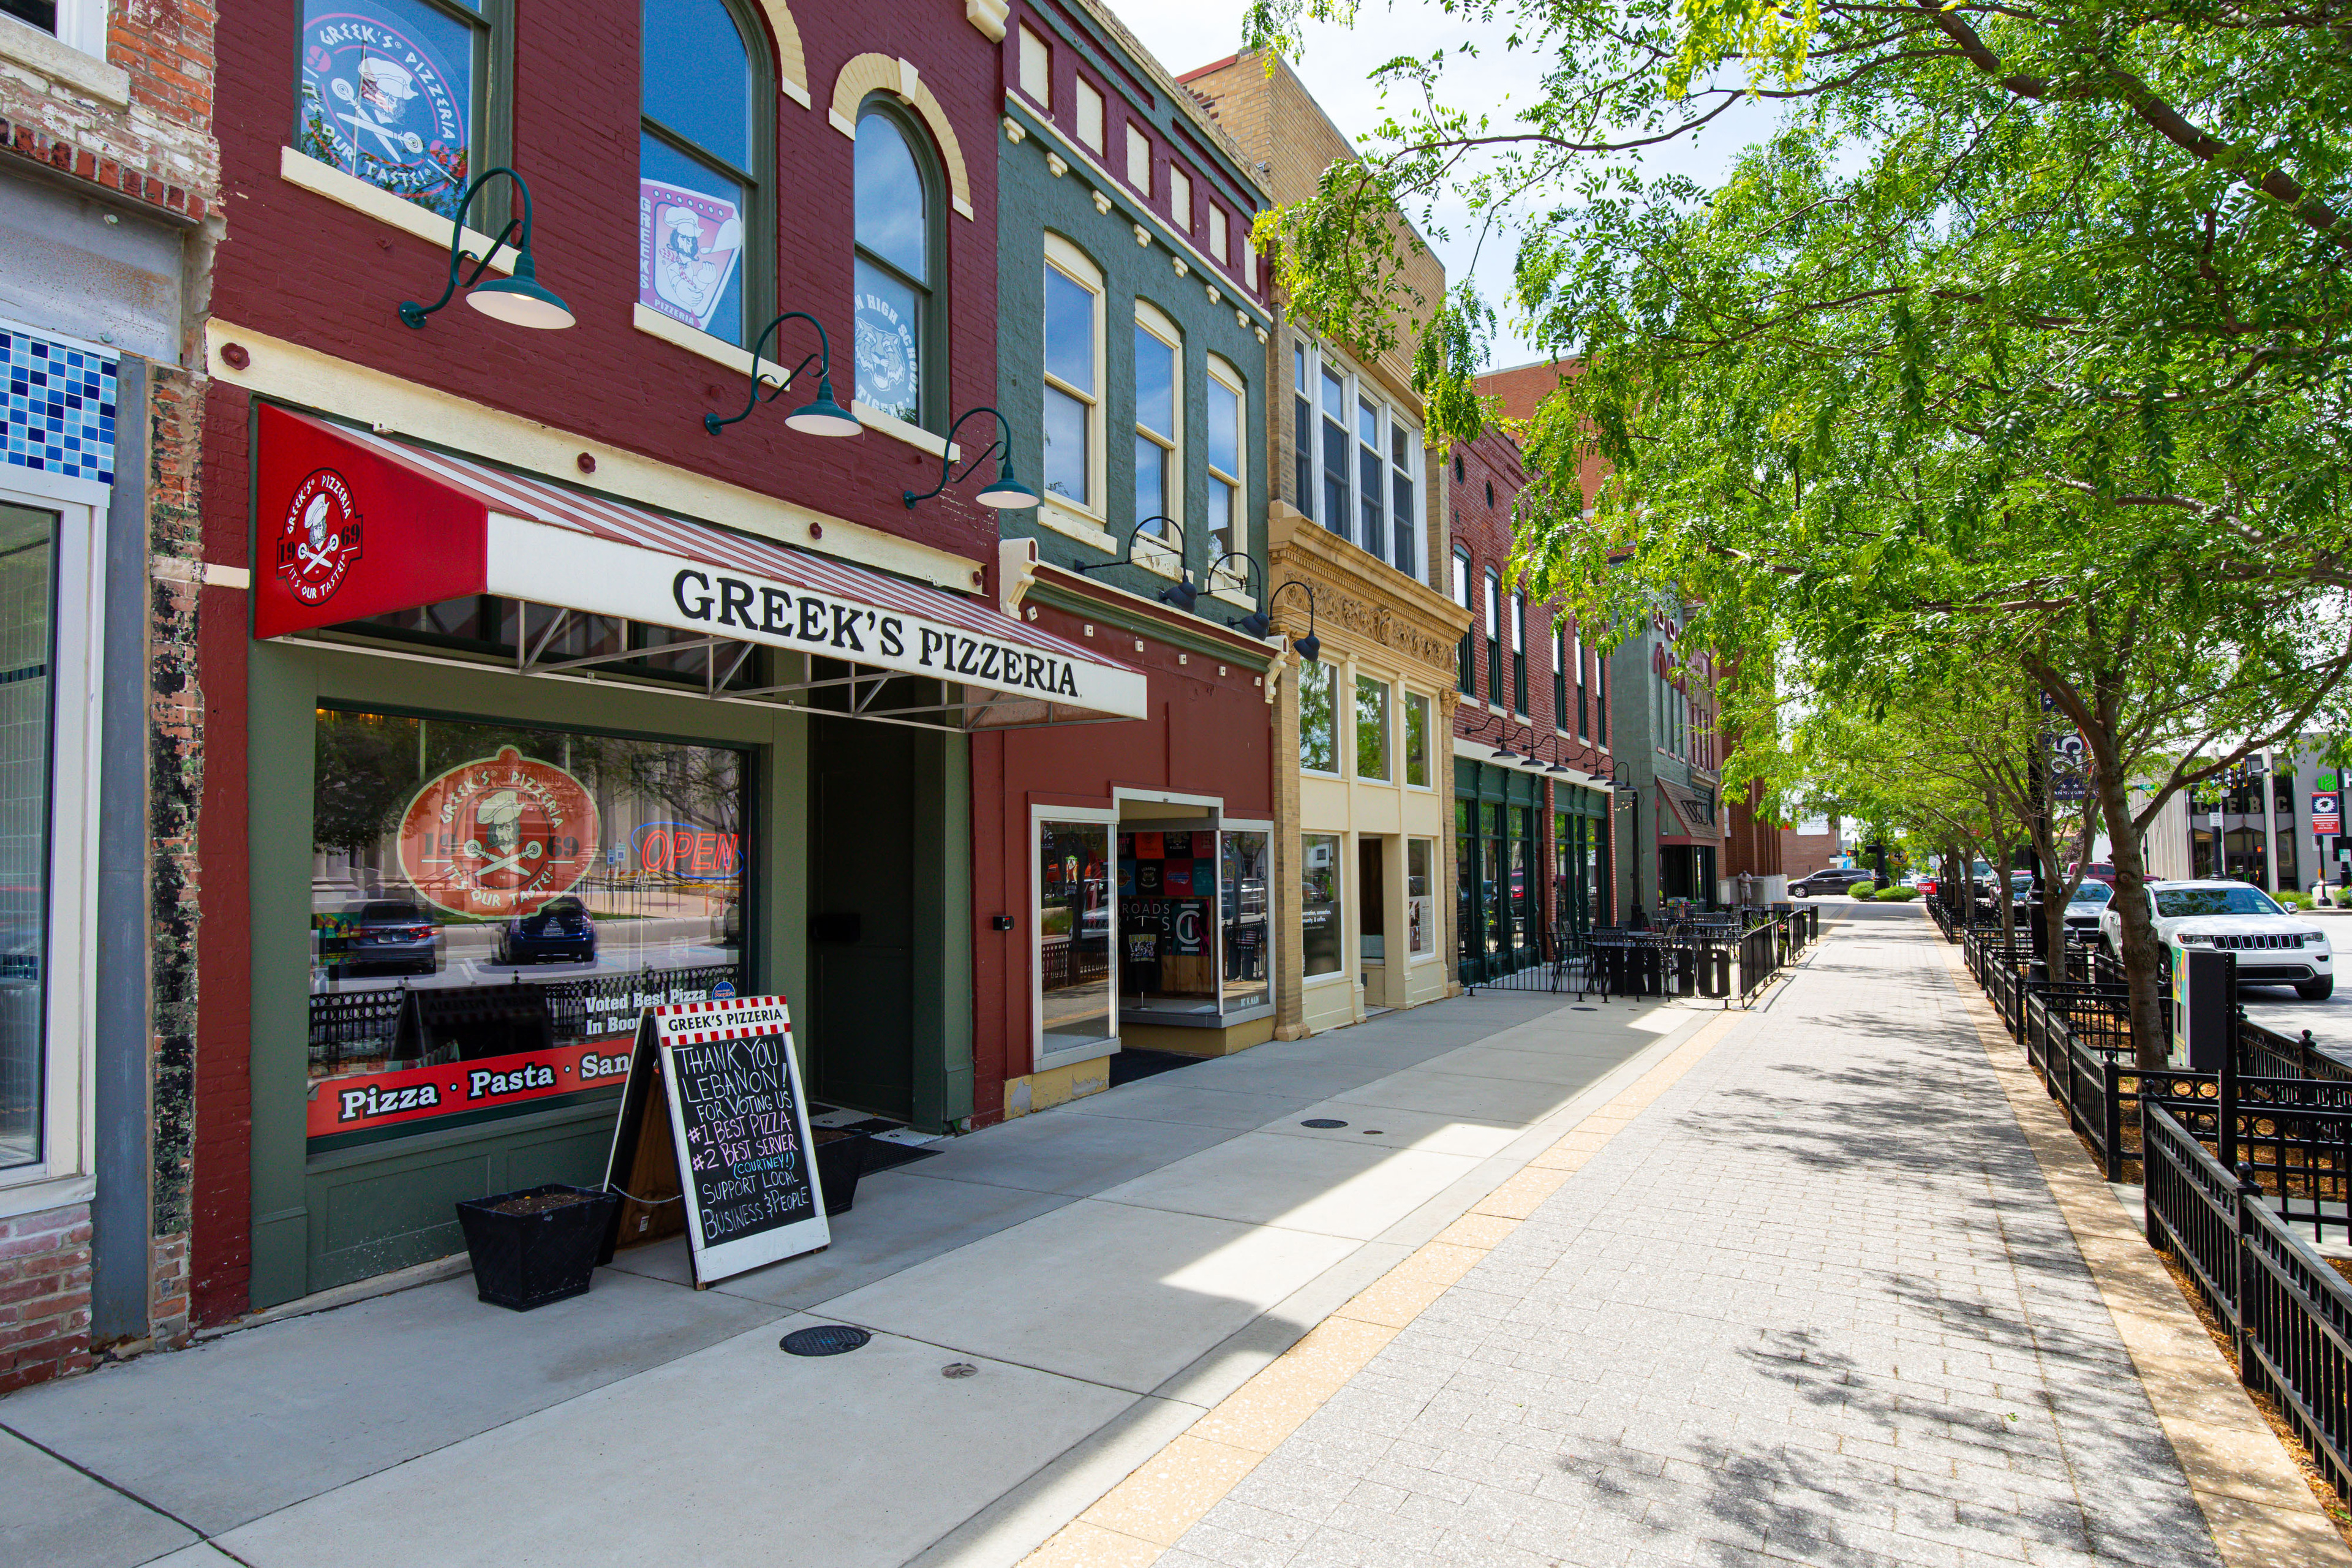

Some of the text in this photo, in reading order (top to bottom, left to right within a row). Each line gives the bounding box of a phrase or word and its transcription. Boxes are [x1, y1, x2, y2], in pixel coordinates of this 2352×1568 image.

[405, 51, 456, 139] PIZZERIA
[322, 123, 355, 162] OUR
[655, 299, 695, 326] PIZZERIA
[867, 294, 918, 393] HIGH SCHOOL
[322, 475, 352, 519] PIZZERIA
[280, 541, 296, 563] 19
[341, 524, 361, 546] 69
[289, 567, 301, 587] IT'S
[301, 586, 317, 599] OUR
[673, 569, 1079, 698] GREEK'S PIZZERIA
[511, 770, 564, 829] PIZZERIA
[422, 832, 458, 856] 19
[546, 835, 580, 858] 69
[642, 830, 739, 872] OPEN
[443, 864, 469, 891] IT'S
[470, 889, 502, 907] OUR
[586, 988, 707, 1012] Voted Best Pizza
[586, 1019, 603, 1035] In
[668, 1009, 783, 1032] GREEK'S PIZZERIA
[673, 1038, 778, 1075] THANK YOU
[342, 1054, 630, 1118] Pizza Pasta San
[696, 1090, 793, 1123] FOR VOTING US
[687, 1110, 792, 1146] #1 BEST PIZZA
[692, 1134, 798, 1172] #2 BEST SERVER
[702, 1171, 799, 1204] SUPPORT LOCAL
[701, 1202, 764, 1240] BUSINESS
